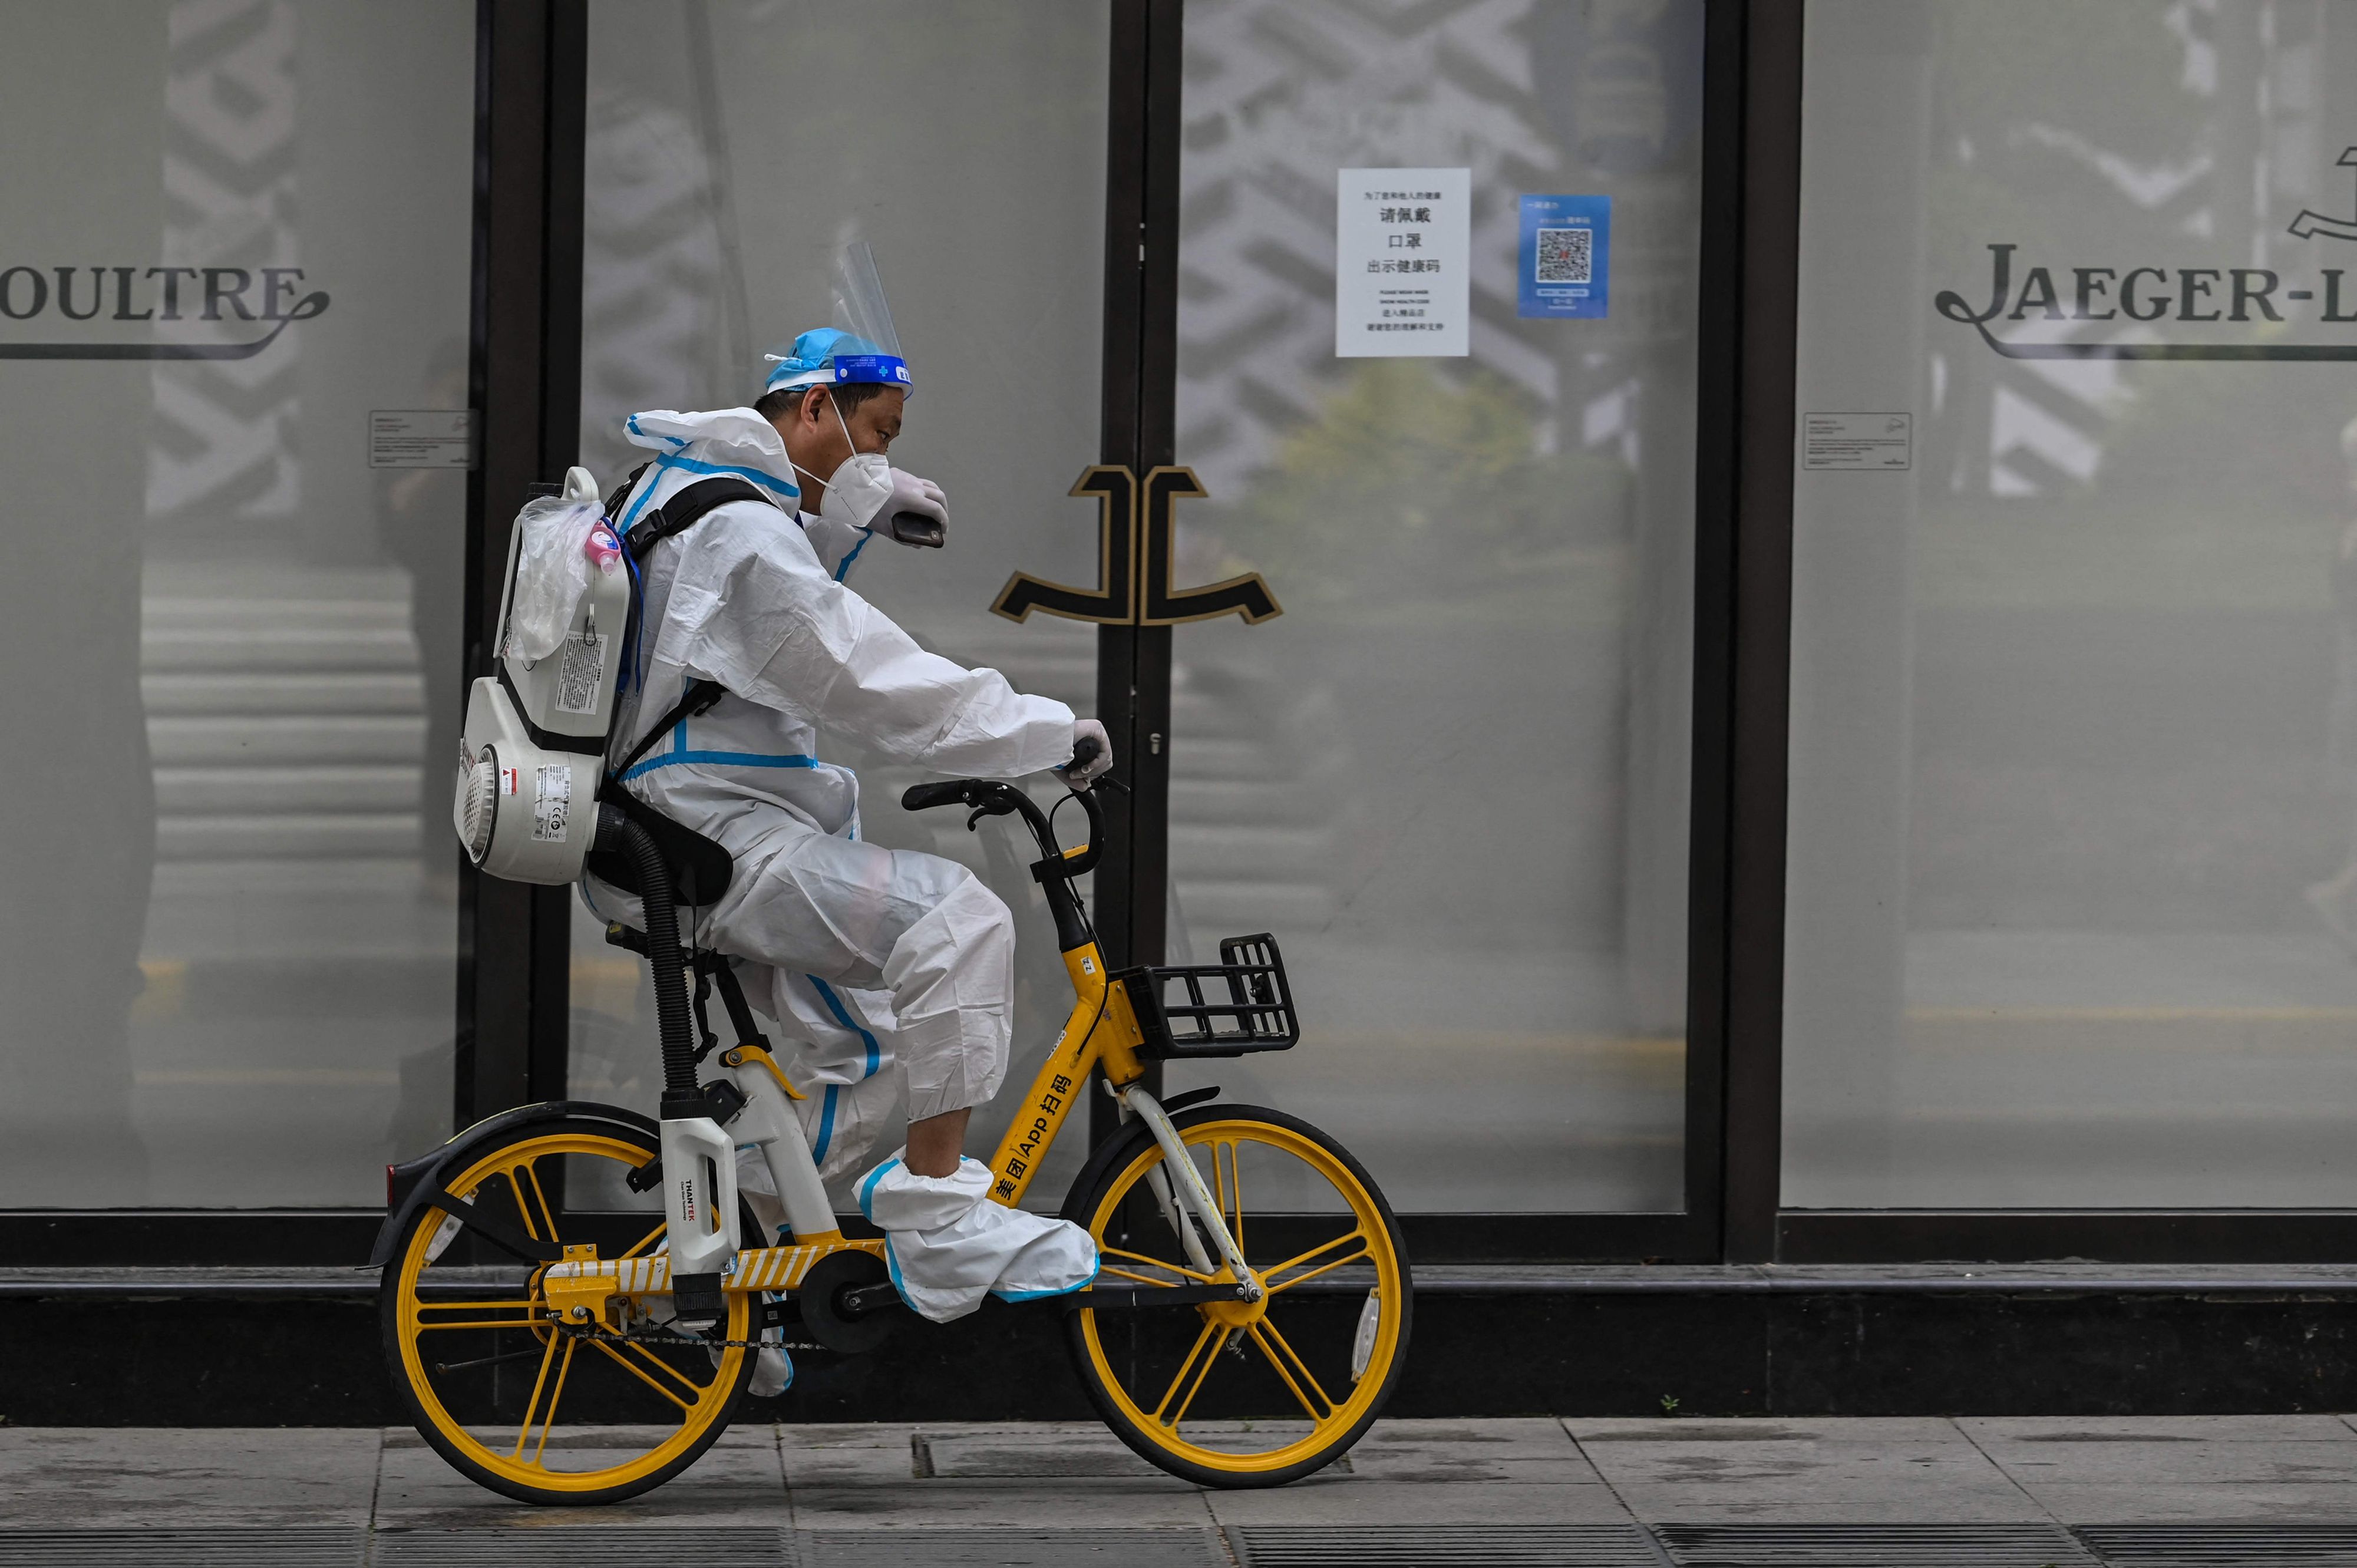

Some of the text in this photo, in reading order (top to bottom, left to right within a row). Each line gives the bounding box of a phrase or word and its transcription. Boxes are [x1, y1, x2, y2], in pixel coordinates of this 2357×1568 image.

[1380, 207, 1431, 223] 请佩戴
[1389, 233, 1422, 249] 口罩
[1367, 259, 1440, 273] 出示健康码
[1935, 244, 2357, 323] JAEGER-L
[0, 266, 330, 321] OULTRE
[996, 1157, 1027, 1200] 美团
[1019, 1117, 1047, 1157] App
[1040, 1074, 1072, 1116] 扫码
[686, 1179, 695, 1221] THANTEK
